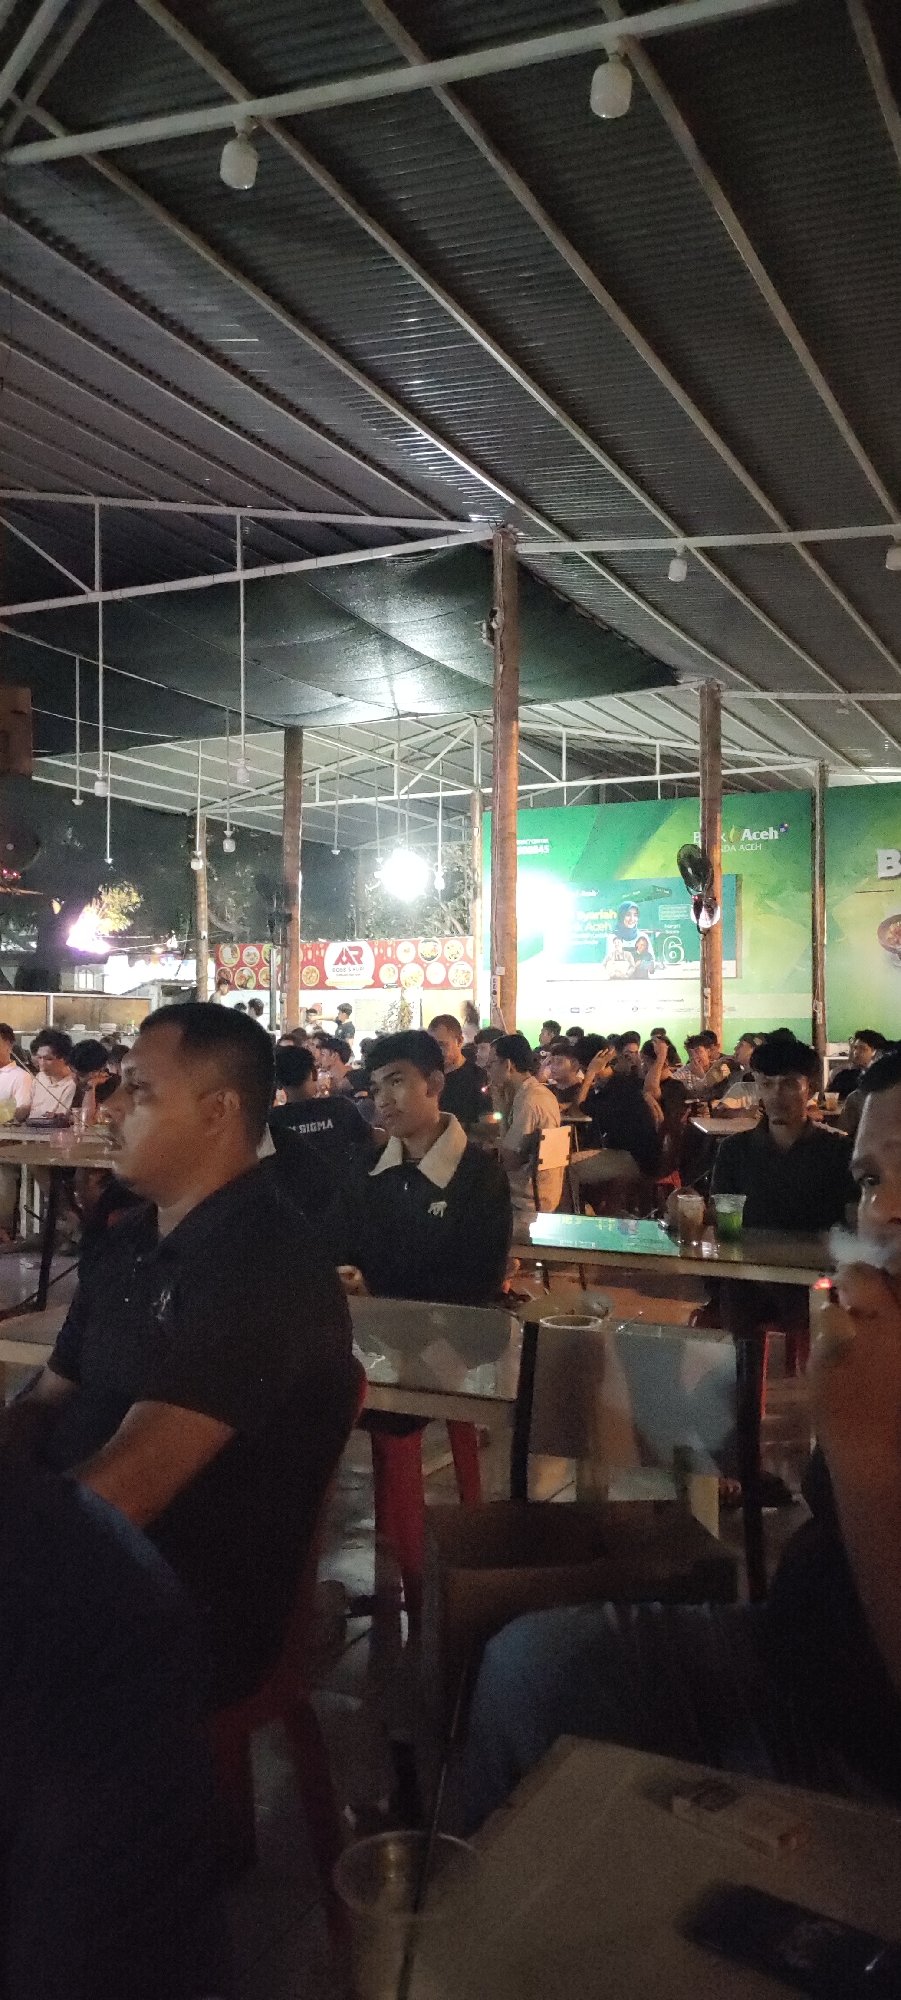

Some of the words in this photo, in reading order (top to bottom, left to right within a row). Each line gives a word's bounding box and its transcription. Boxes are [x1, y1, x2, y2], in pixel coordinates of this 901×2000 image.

[741, 827, 779, 841] Aceh
[738, 843, 762, 852] ACEH
[333, 945, 363, 966] AR
[662, 935, 685, 965] 6
[298, 1118, 334, 1134] SIGMA
